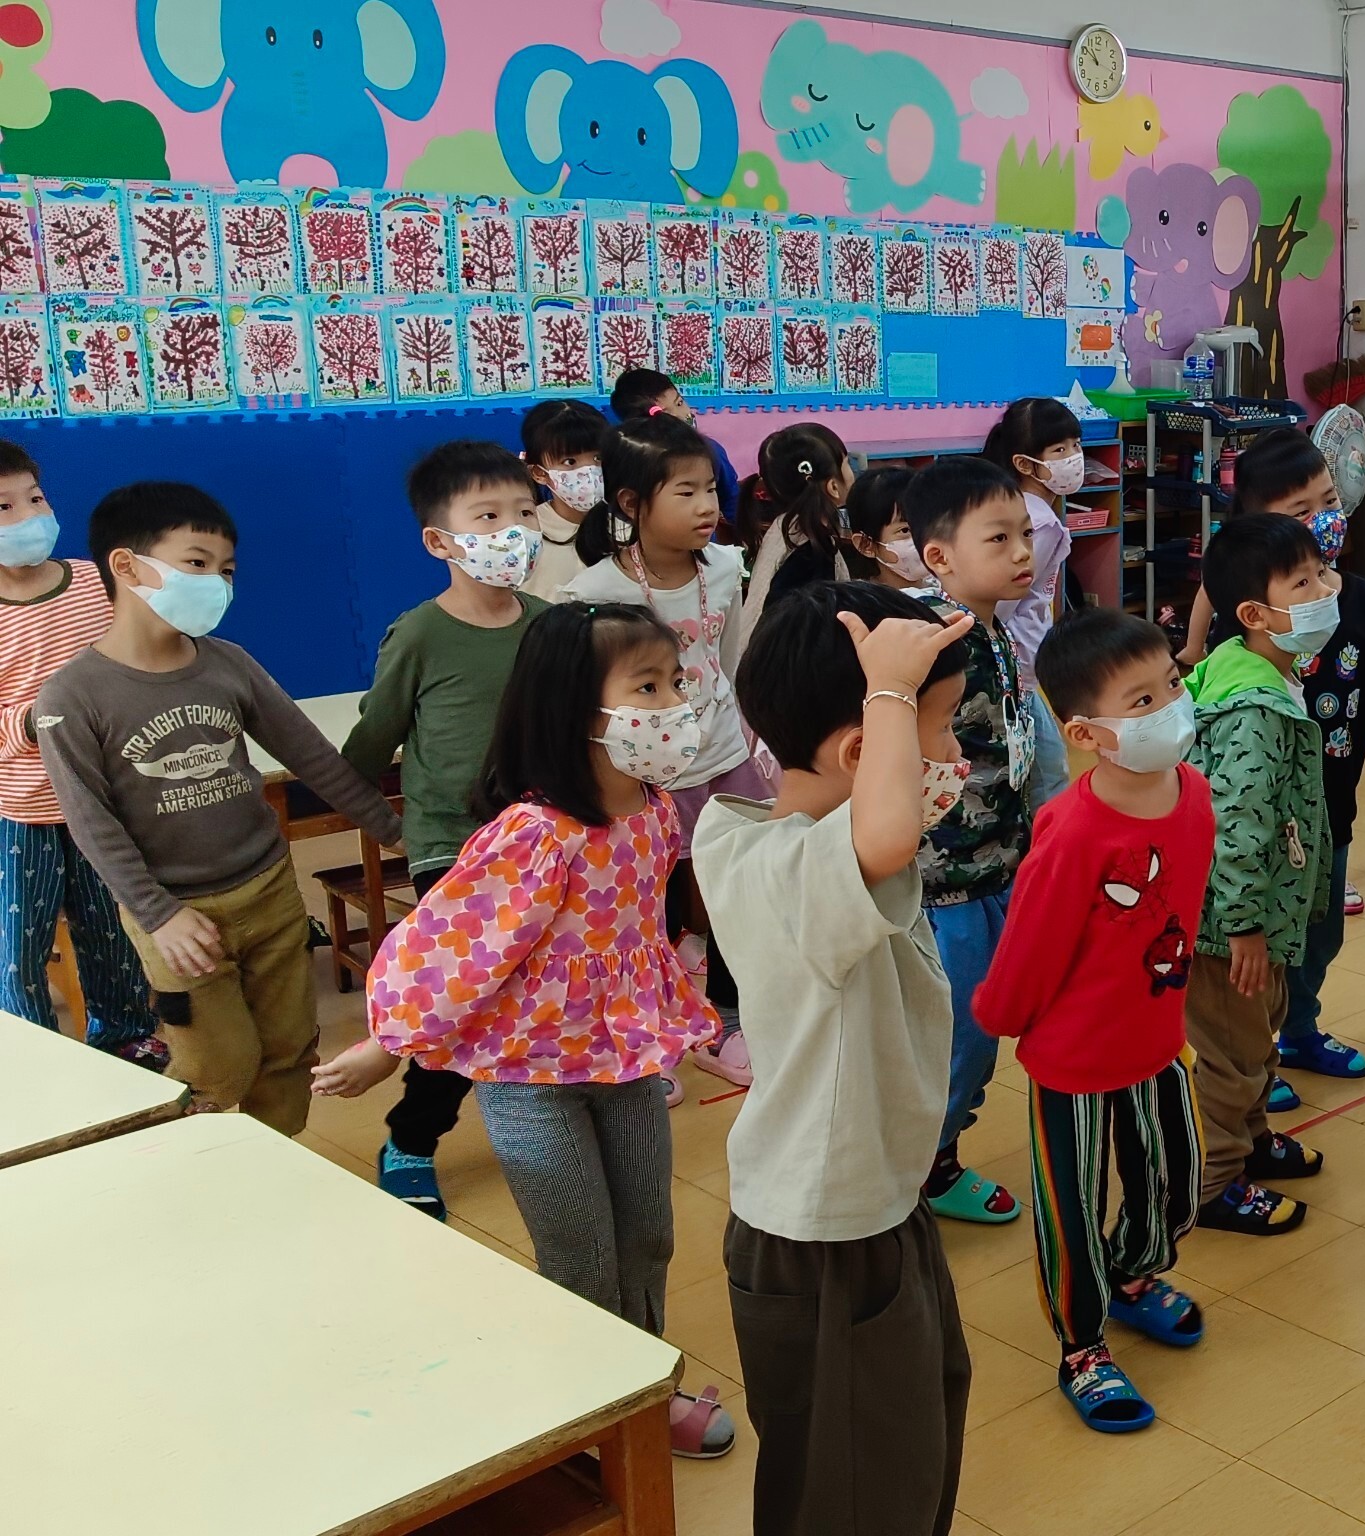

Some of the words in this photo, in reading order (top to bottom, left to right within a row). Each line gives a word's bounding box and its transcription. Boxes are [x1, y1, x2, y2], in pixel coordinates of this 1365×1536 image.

[1095, 36, 1102, 46] 12
[1110, 49, 1115, 58] 2
[1079, 57, 1084, 66] 9
[1112, 61, 1117, 70] 3
[1080, 69, 1086, 78] 8
[1109, 73, 1114, 81] 4
[1087, 78, 1092, 87] 7
[1095, 82, 1100, 91] 6
[1103, 80, 1108, 89] 5
[121, 707, 185, 762] STRAIGHT
[163, 749, 225, 774] MINICONCE
[161, 776, 227, 801] ESTABLISHED
[156, 789, 224, 815] AMERICAN
